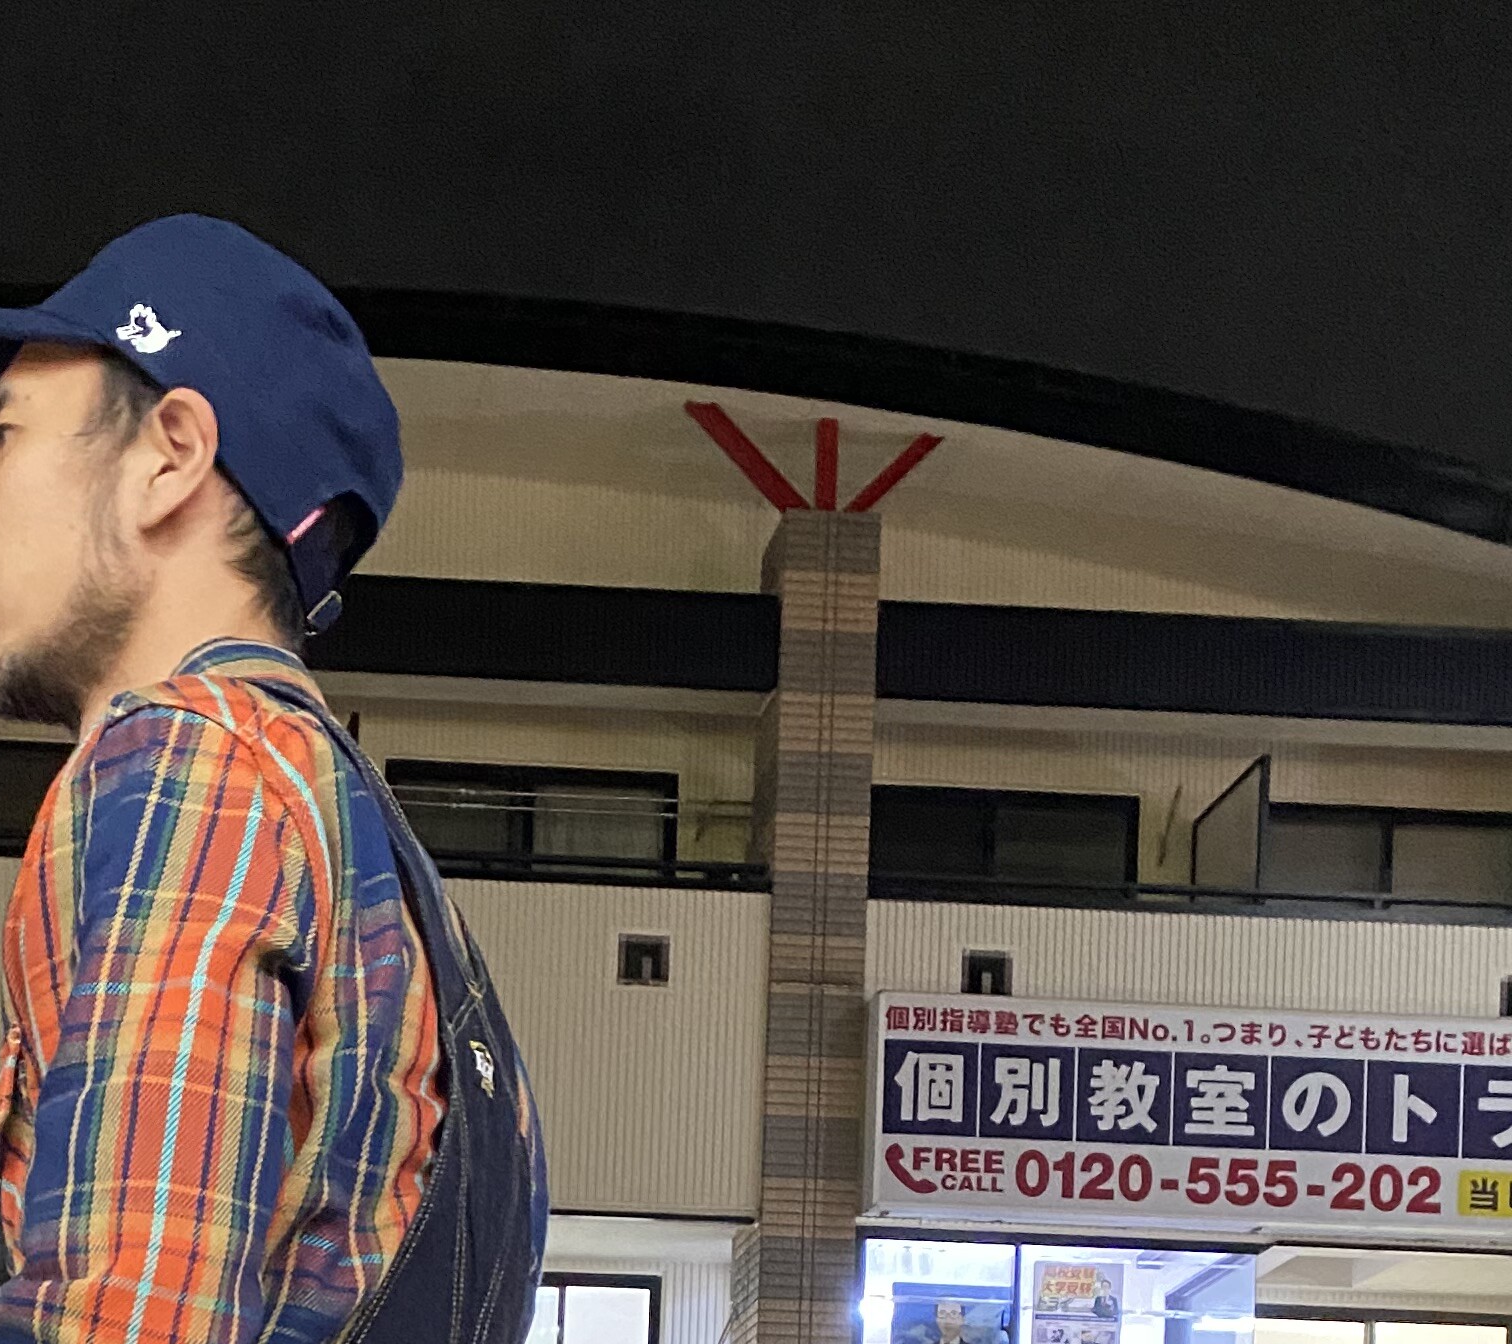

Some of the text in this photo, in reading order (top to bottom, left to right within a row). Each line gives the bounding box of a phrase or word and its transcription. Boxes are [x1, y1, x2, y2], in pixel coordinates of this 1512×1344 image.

[912, 1147, 1005, 1174] FREE
[940, 1174, 1004, 1192] CALL
[1014, 1149, 1441, 1214] 0120-555-202
[1470, 1176, 1512, 1212] 当
